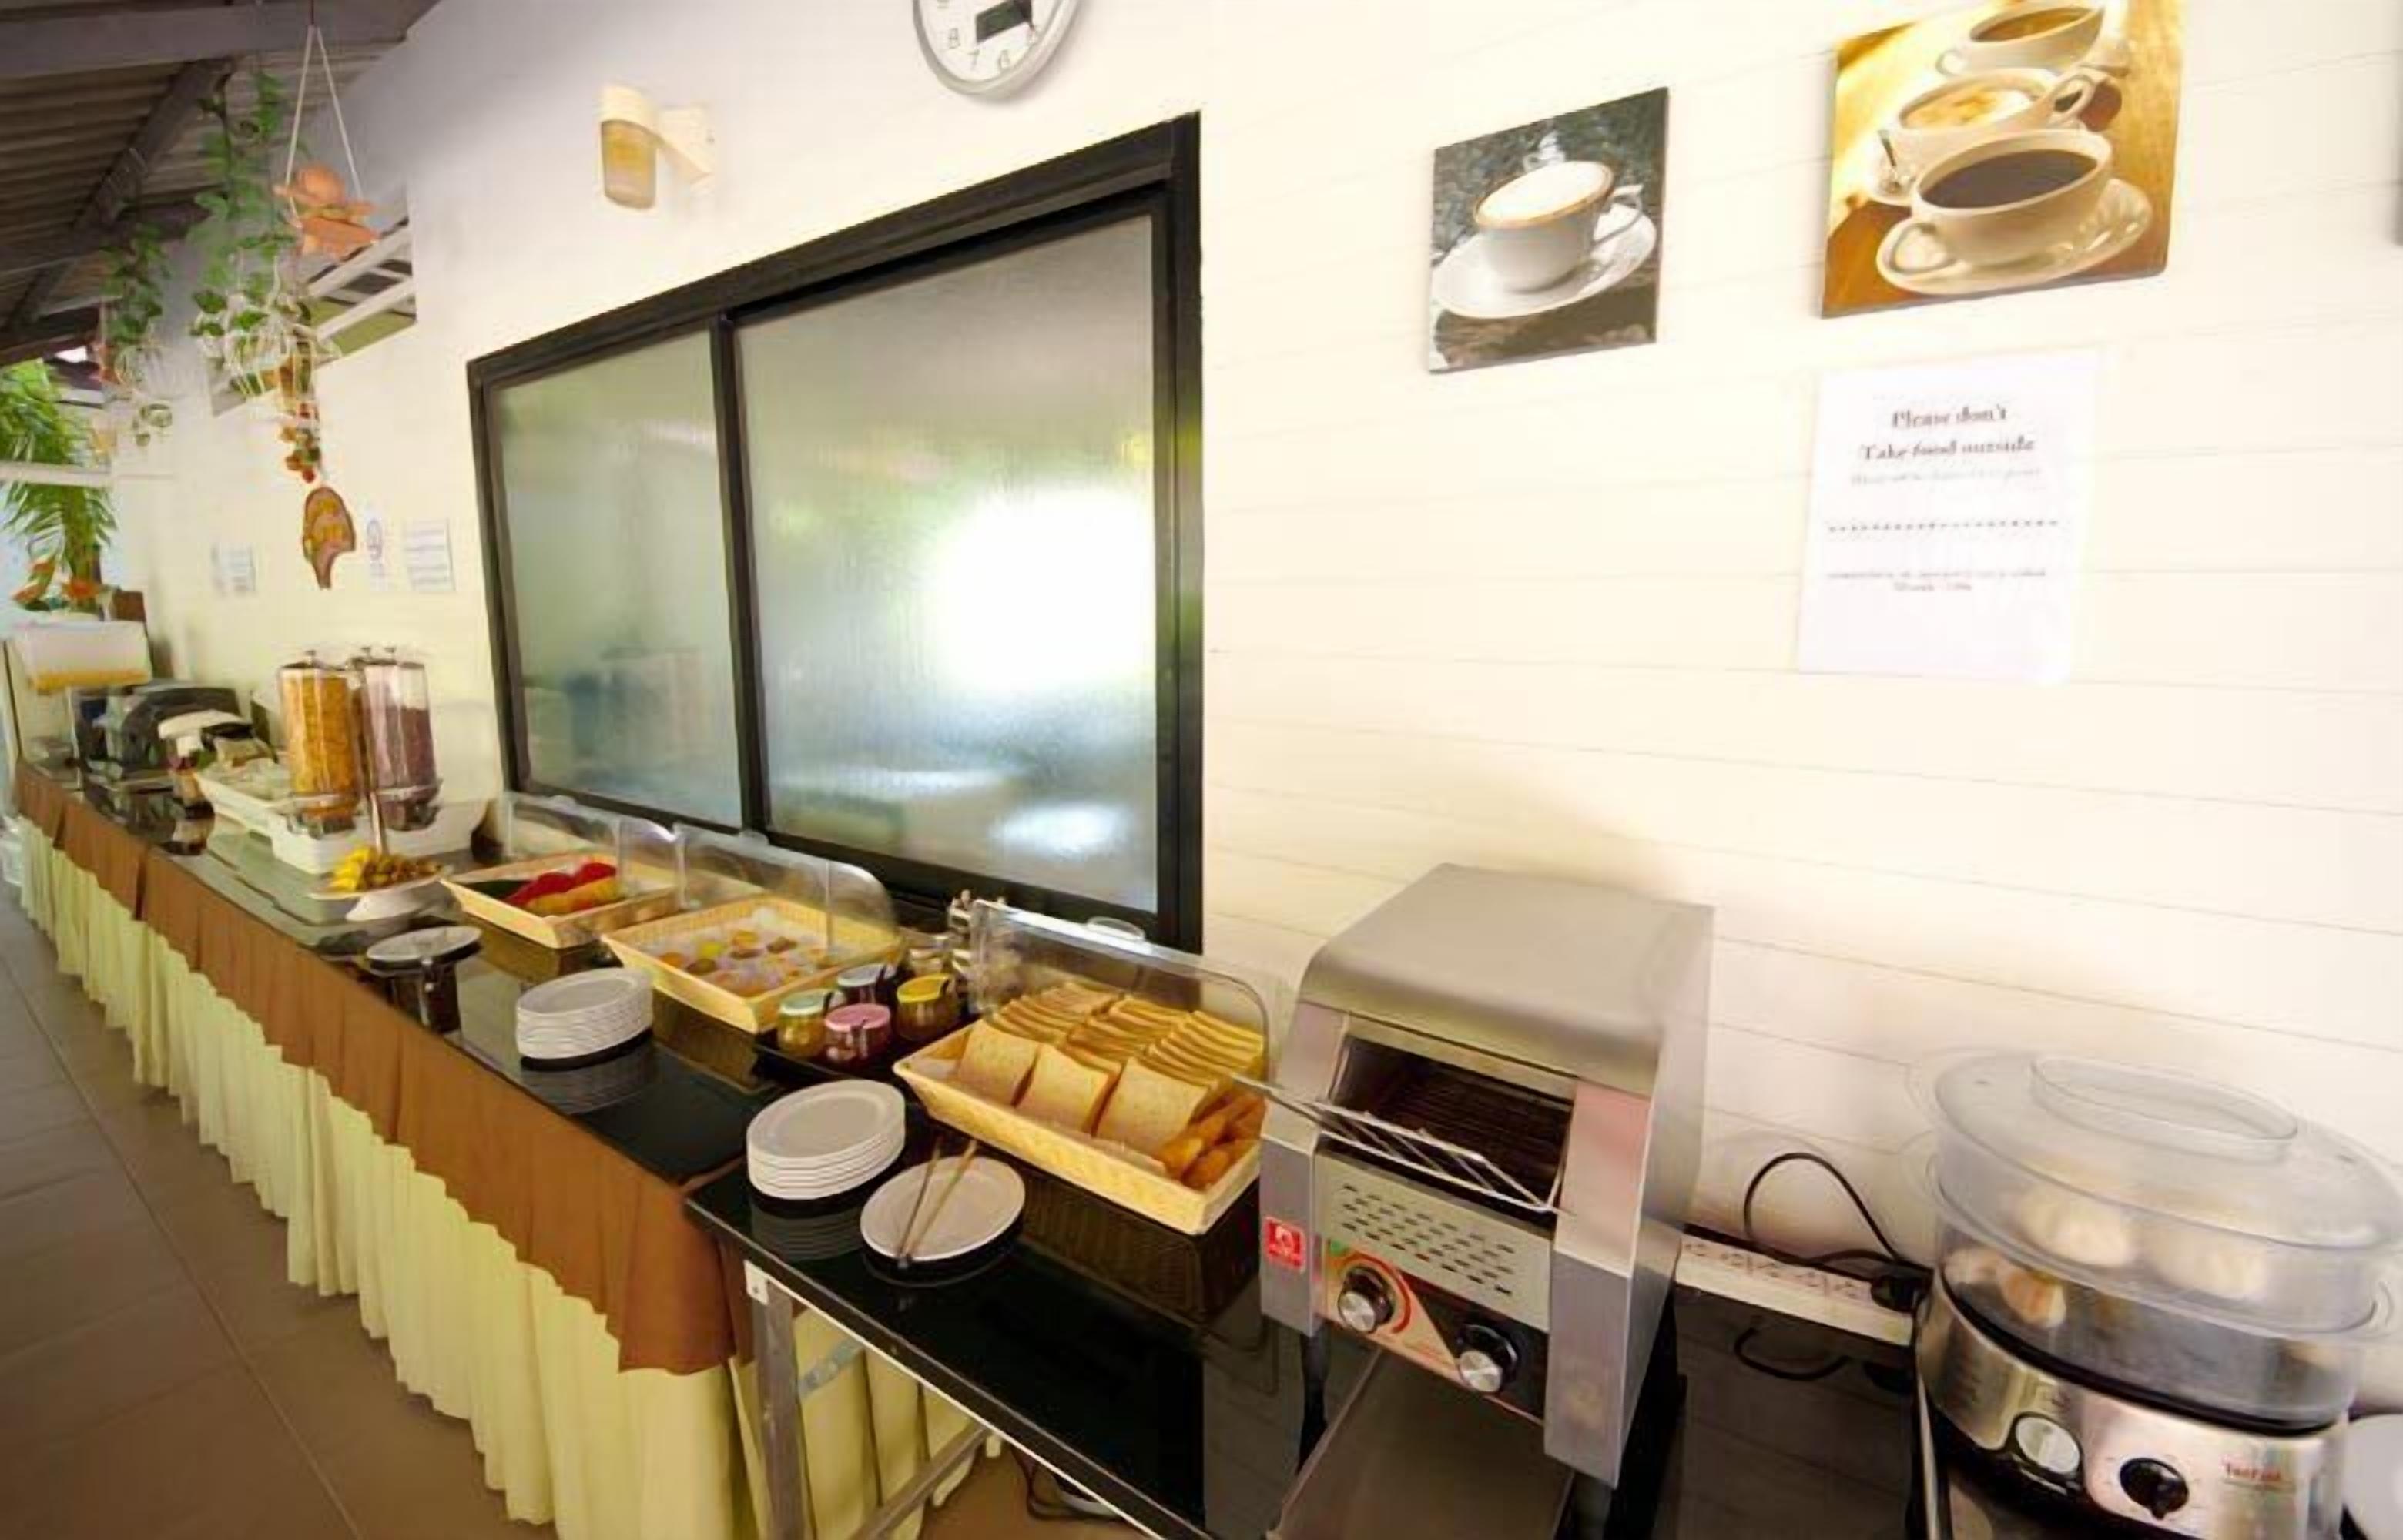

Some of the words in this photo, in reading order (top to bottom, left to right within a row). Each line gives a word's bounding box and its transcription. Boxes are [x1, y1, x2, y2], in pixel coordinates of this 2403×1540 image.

[1892, 407, 1950, 428] Please
[1956, 403, 2006, 423] don't
[1861, 443, 1907, 460] Take
[1912, 440, 1957, 457] food
[1962, 435, 2034, 453] outside
